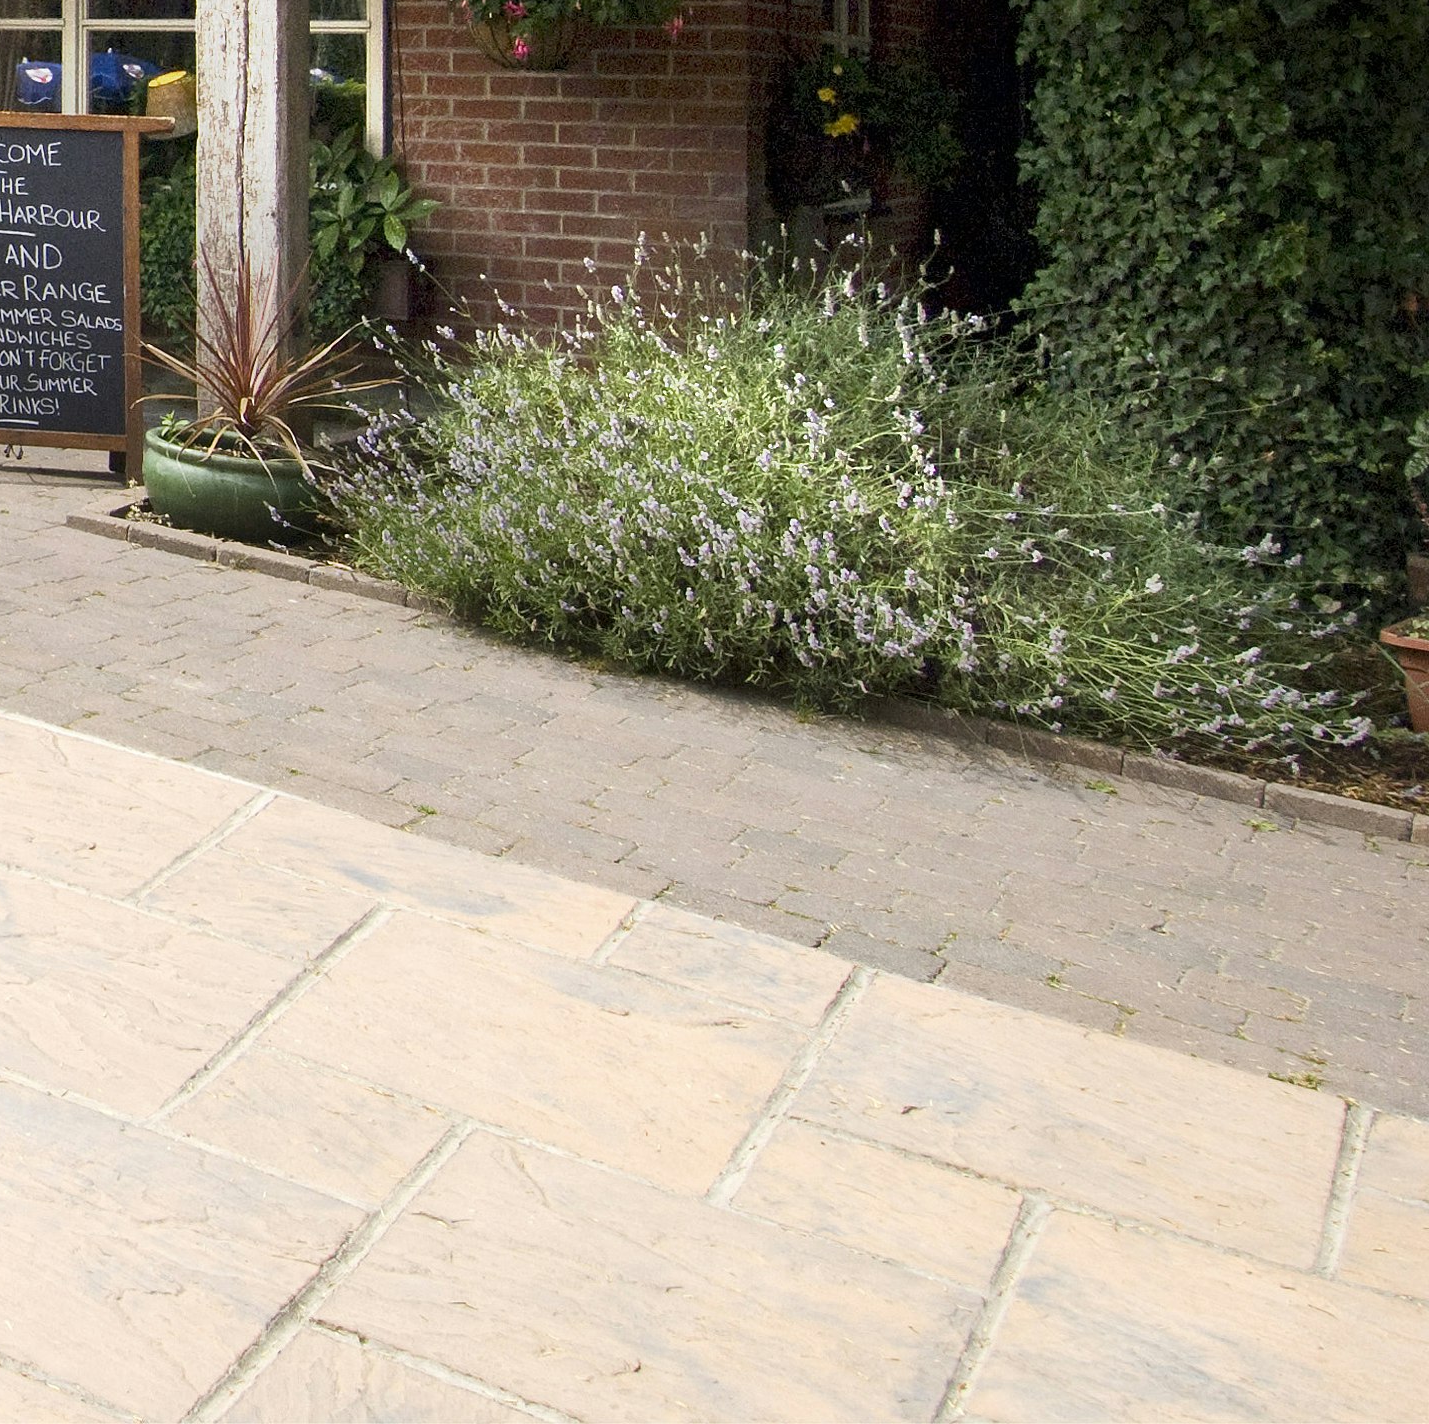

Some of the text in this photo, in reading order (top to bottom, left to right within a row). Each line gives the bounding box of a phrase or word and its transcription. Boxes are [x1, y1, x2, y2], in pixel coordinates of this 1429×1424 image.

[5, 243, 62, 270] AND
[24, 275, 111, 304] RANGE
[60, 309, 123, 331] SALADS
[39, 352, 112, 373] FORGET
[23, 374, 97, 395] SUMMER
